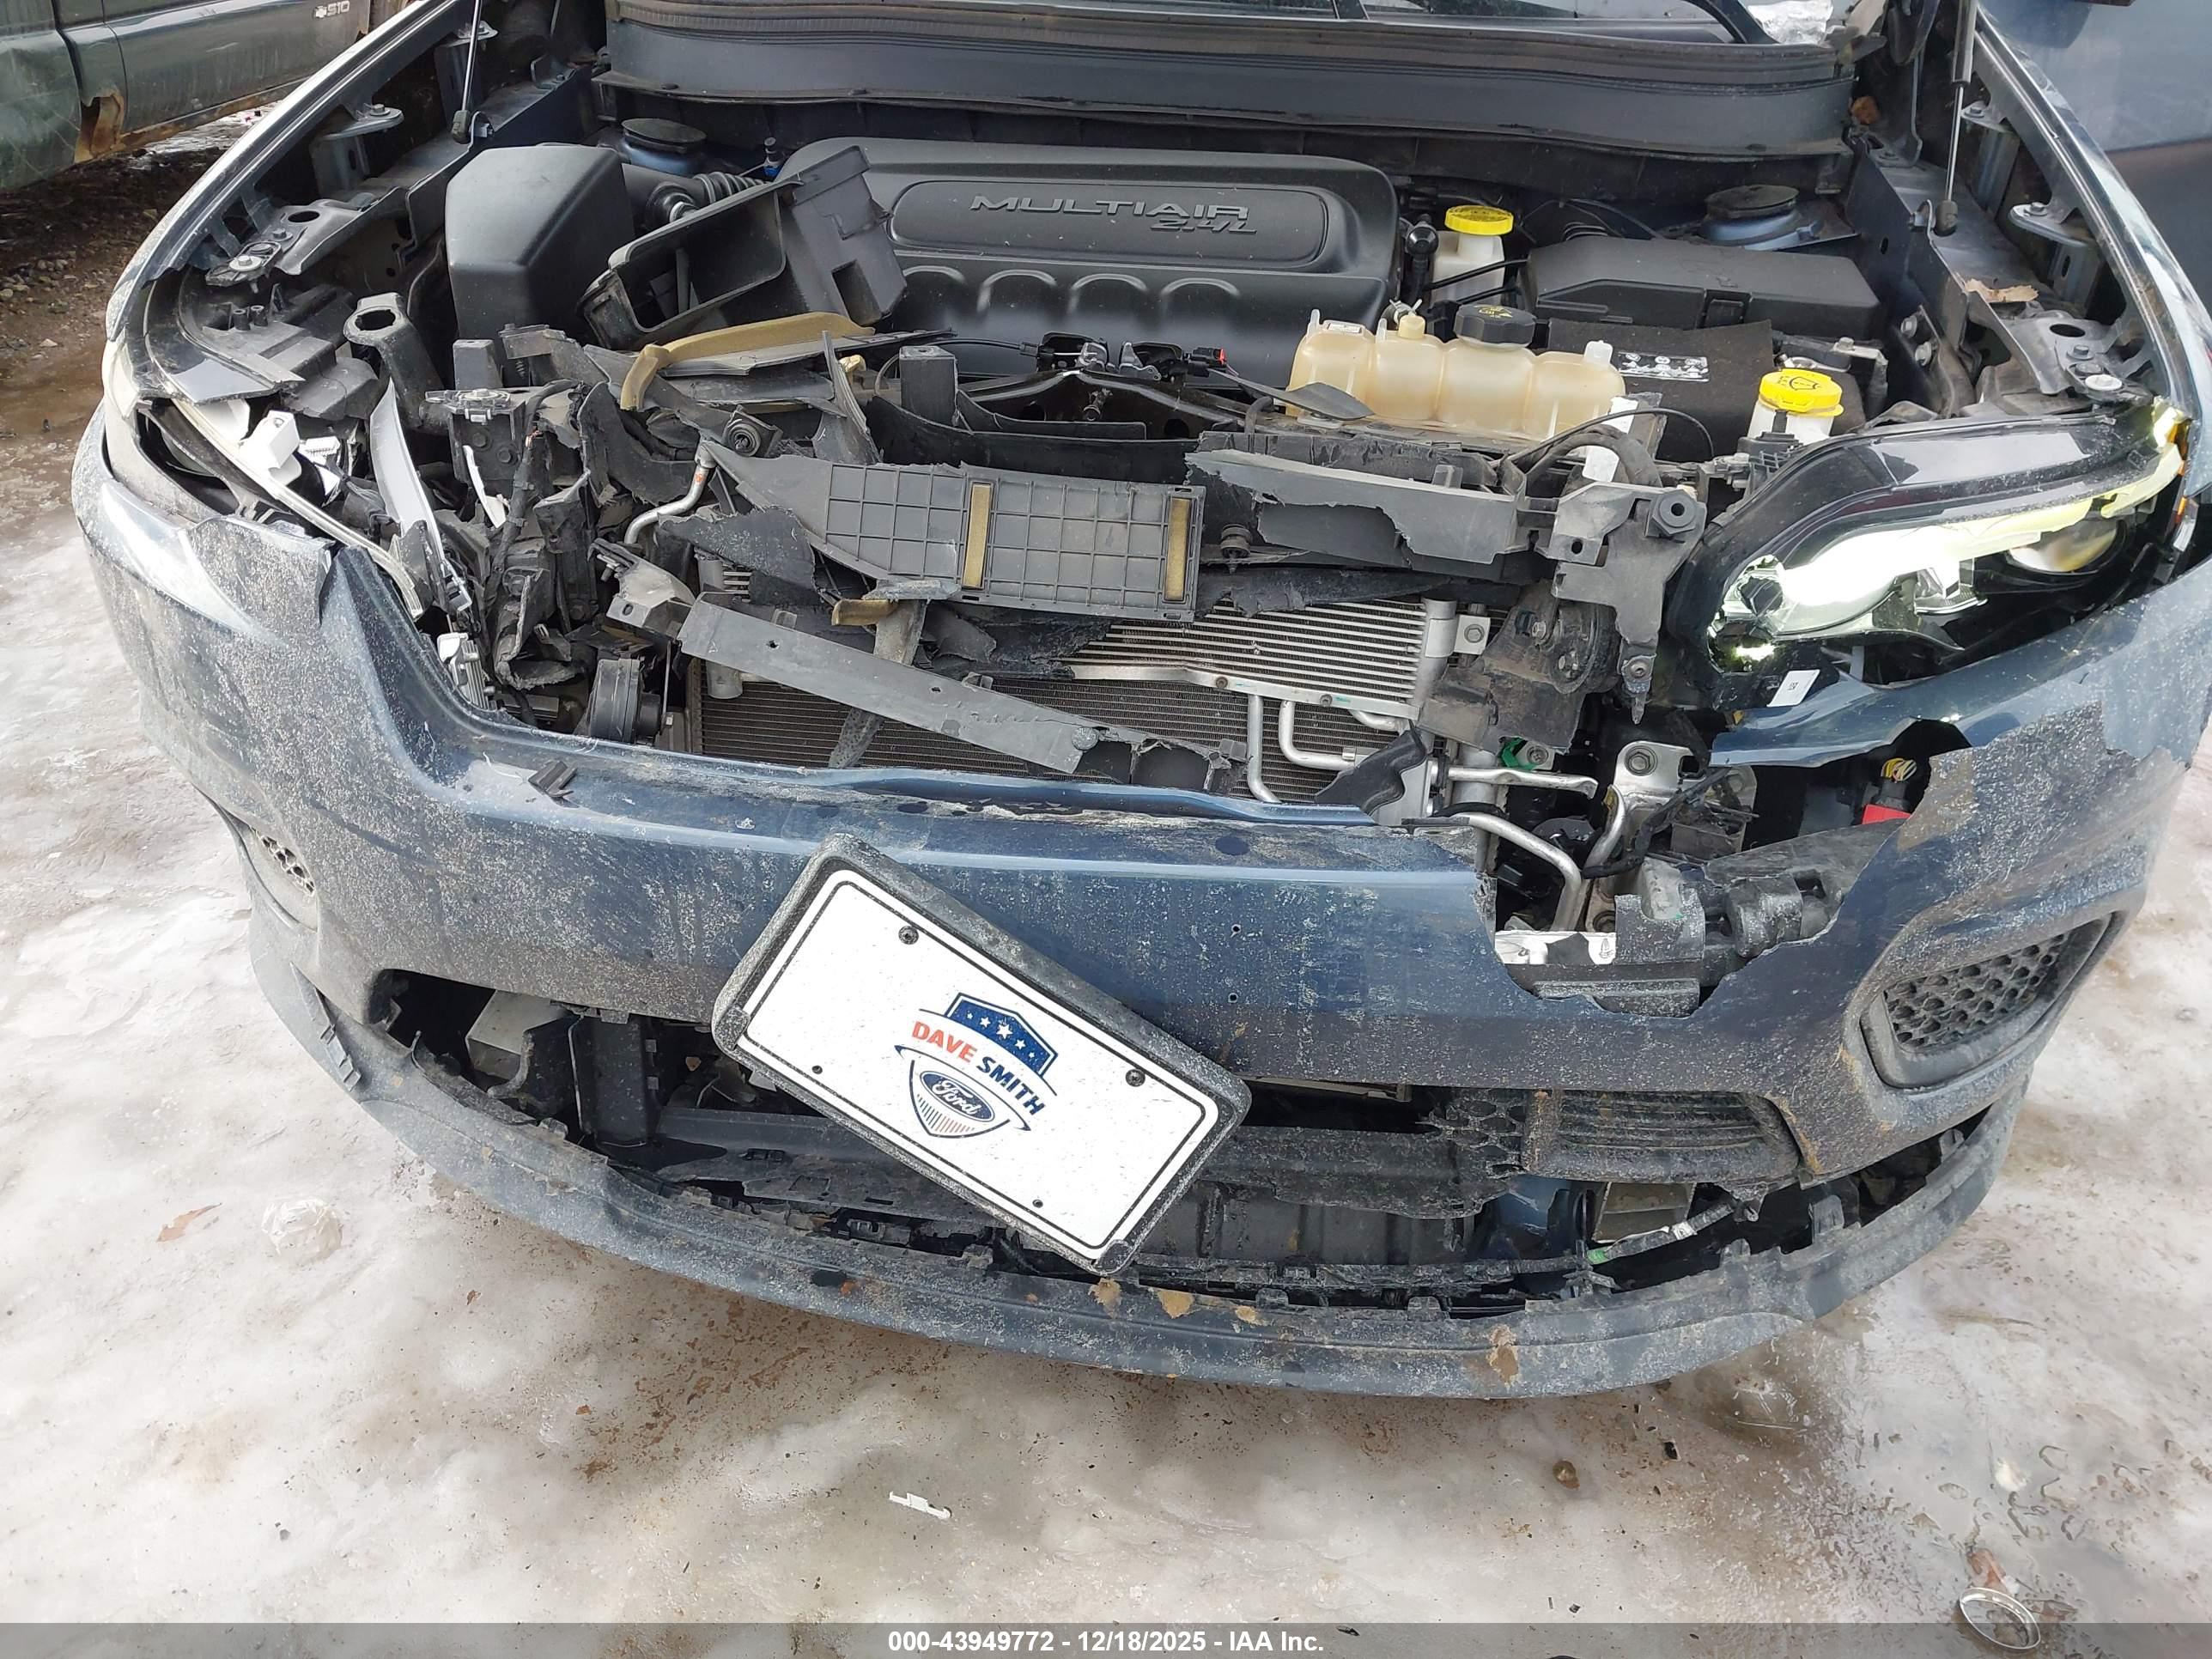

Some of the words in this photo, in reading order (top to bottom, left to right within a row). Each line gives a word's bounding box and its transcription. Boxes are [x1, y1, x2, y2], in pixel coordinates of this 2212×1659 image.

[327, 0, 350, 16] S10
[969, 196, 1250, 220] MULTIAIR
[1150, 218, 1257, 234] 2.4L
[911, 1021, 978, 1064] DAVE
[975, 1056, 1047, 1116] SMITH
[932, 1079, 982, 1115] Ford
